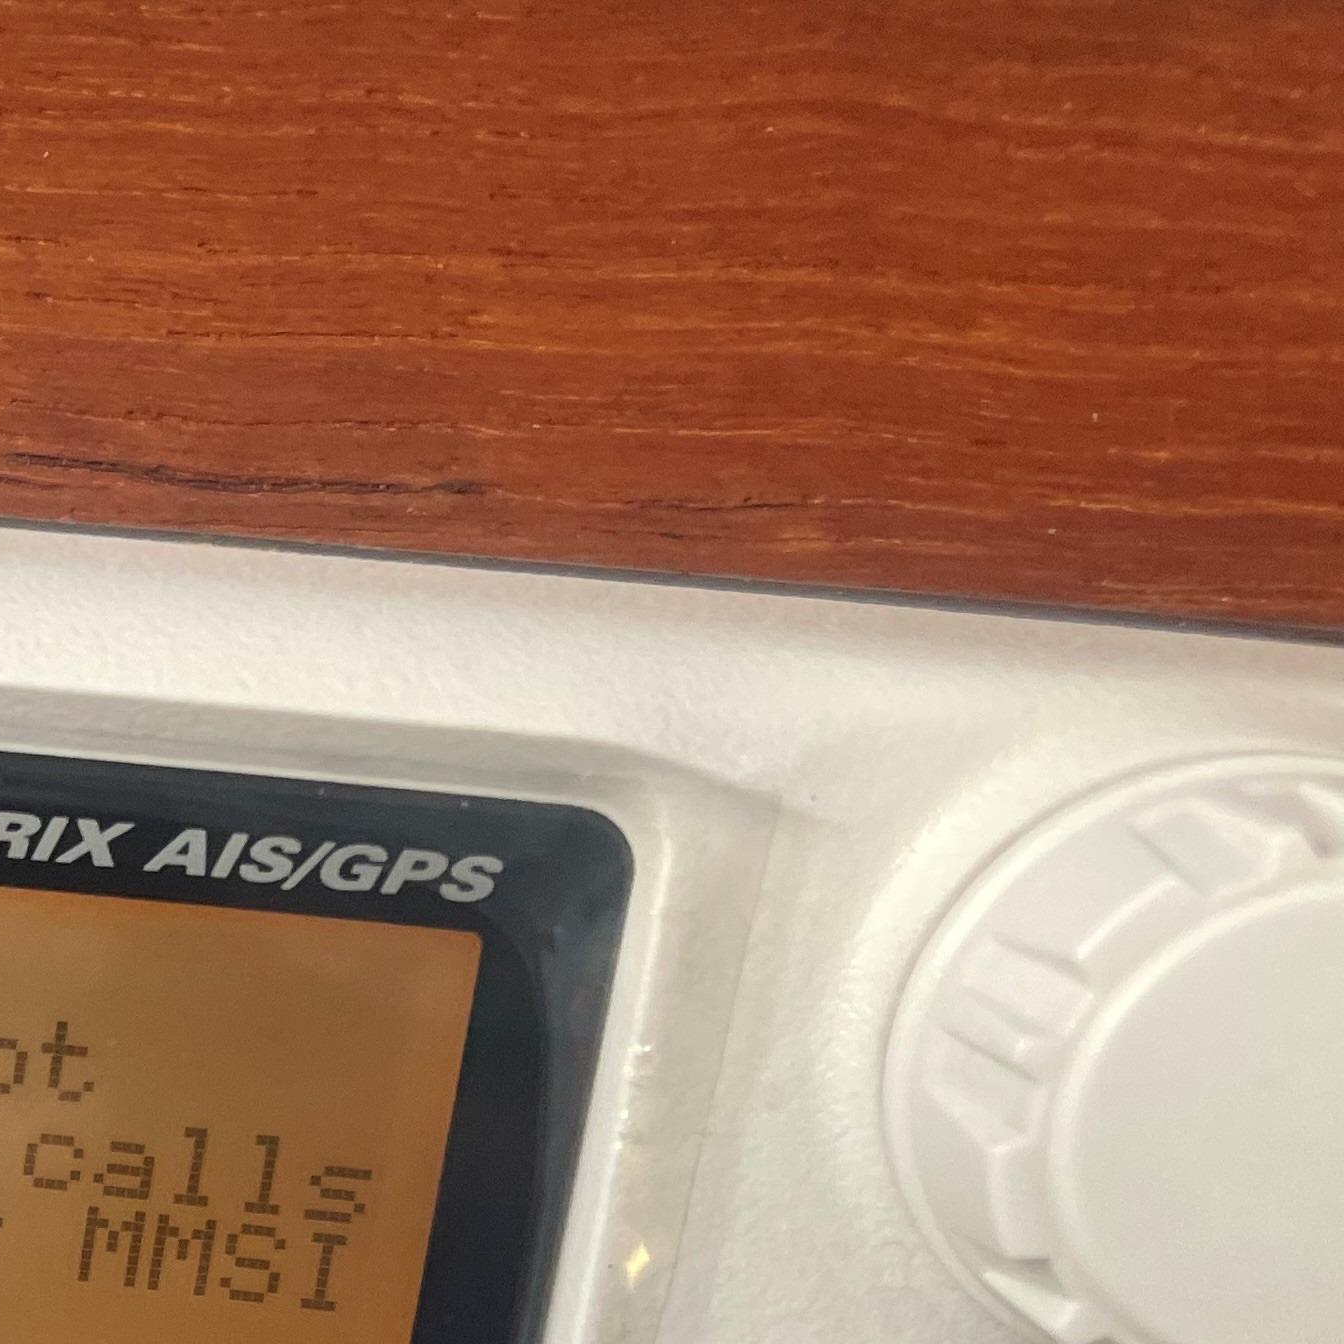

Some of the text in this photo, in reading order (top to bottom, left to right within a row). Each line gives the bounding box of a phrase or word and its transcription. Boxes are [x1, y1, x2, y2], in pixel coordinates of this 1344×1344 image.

[143, 827, 504, 904] AIS/GPS
[22, 1126, 373, 1225] calls
[76, 1205, 349, 1312] MMSI
